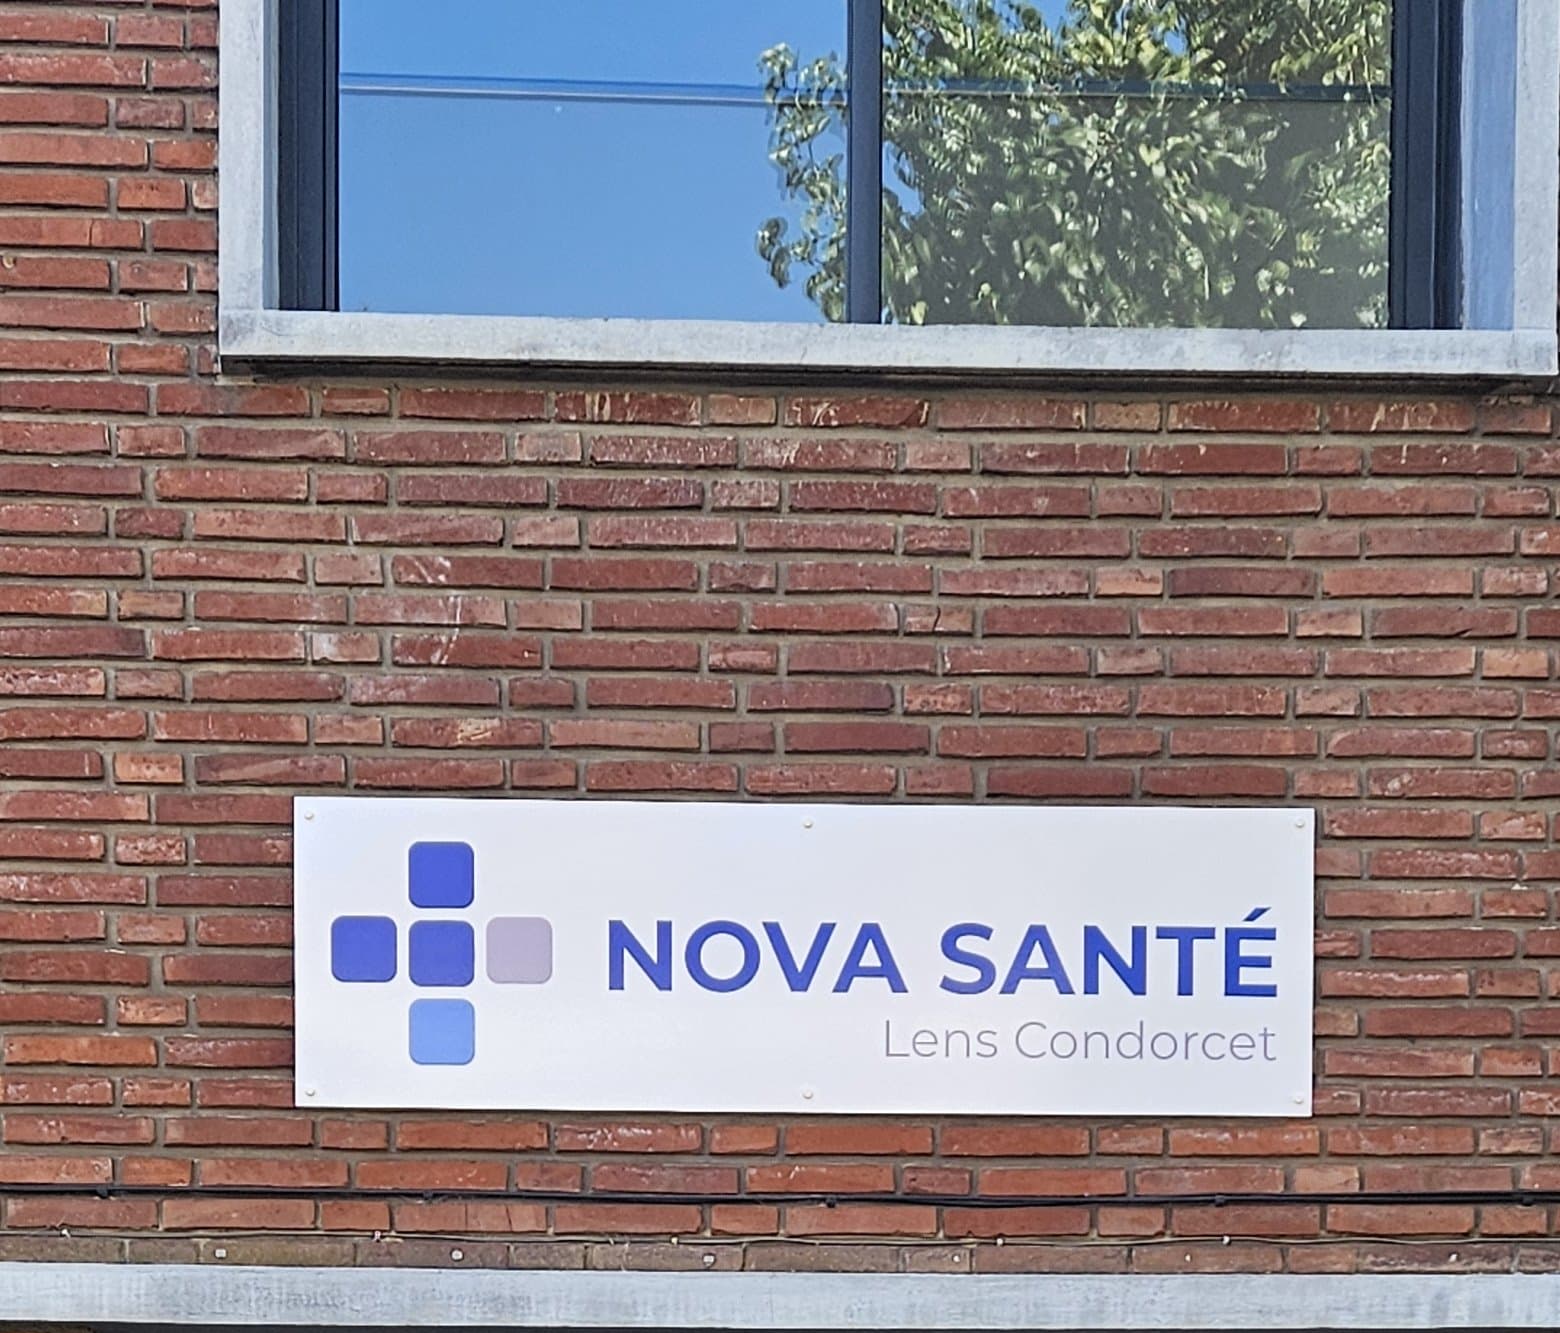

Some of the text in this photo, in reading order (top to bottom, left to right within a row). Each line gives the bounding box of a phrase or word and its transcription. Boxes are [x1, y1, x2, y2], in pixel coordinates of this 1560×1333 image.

[608, 906, 1278, 998] NOVA SANTÉ
[884, 1018, 1278, 1062] Lens Condorcet
